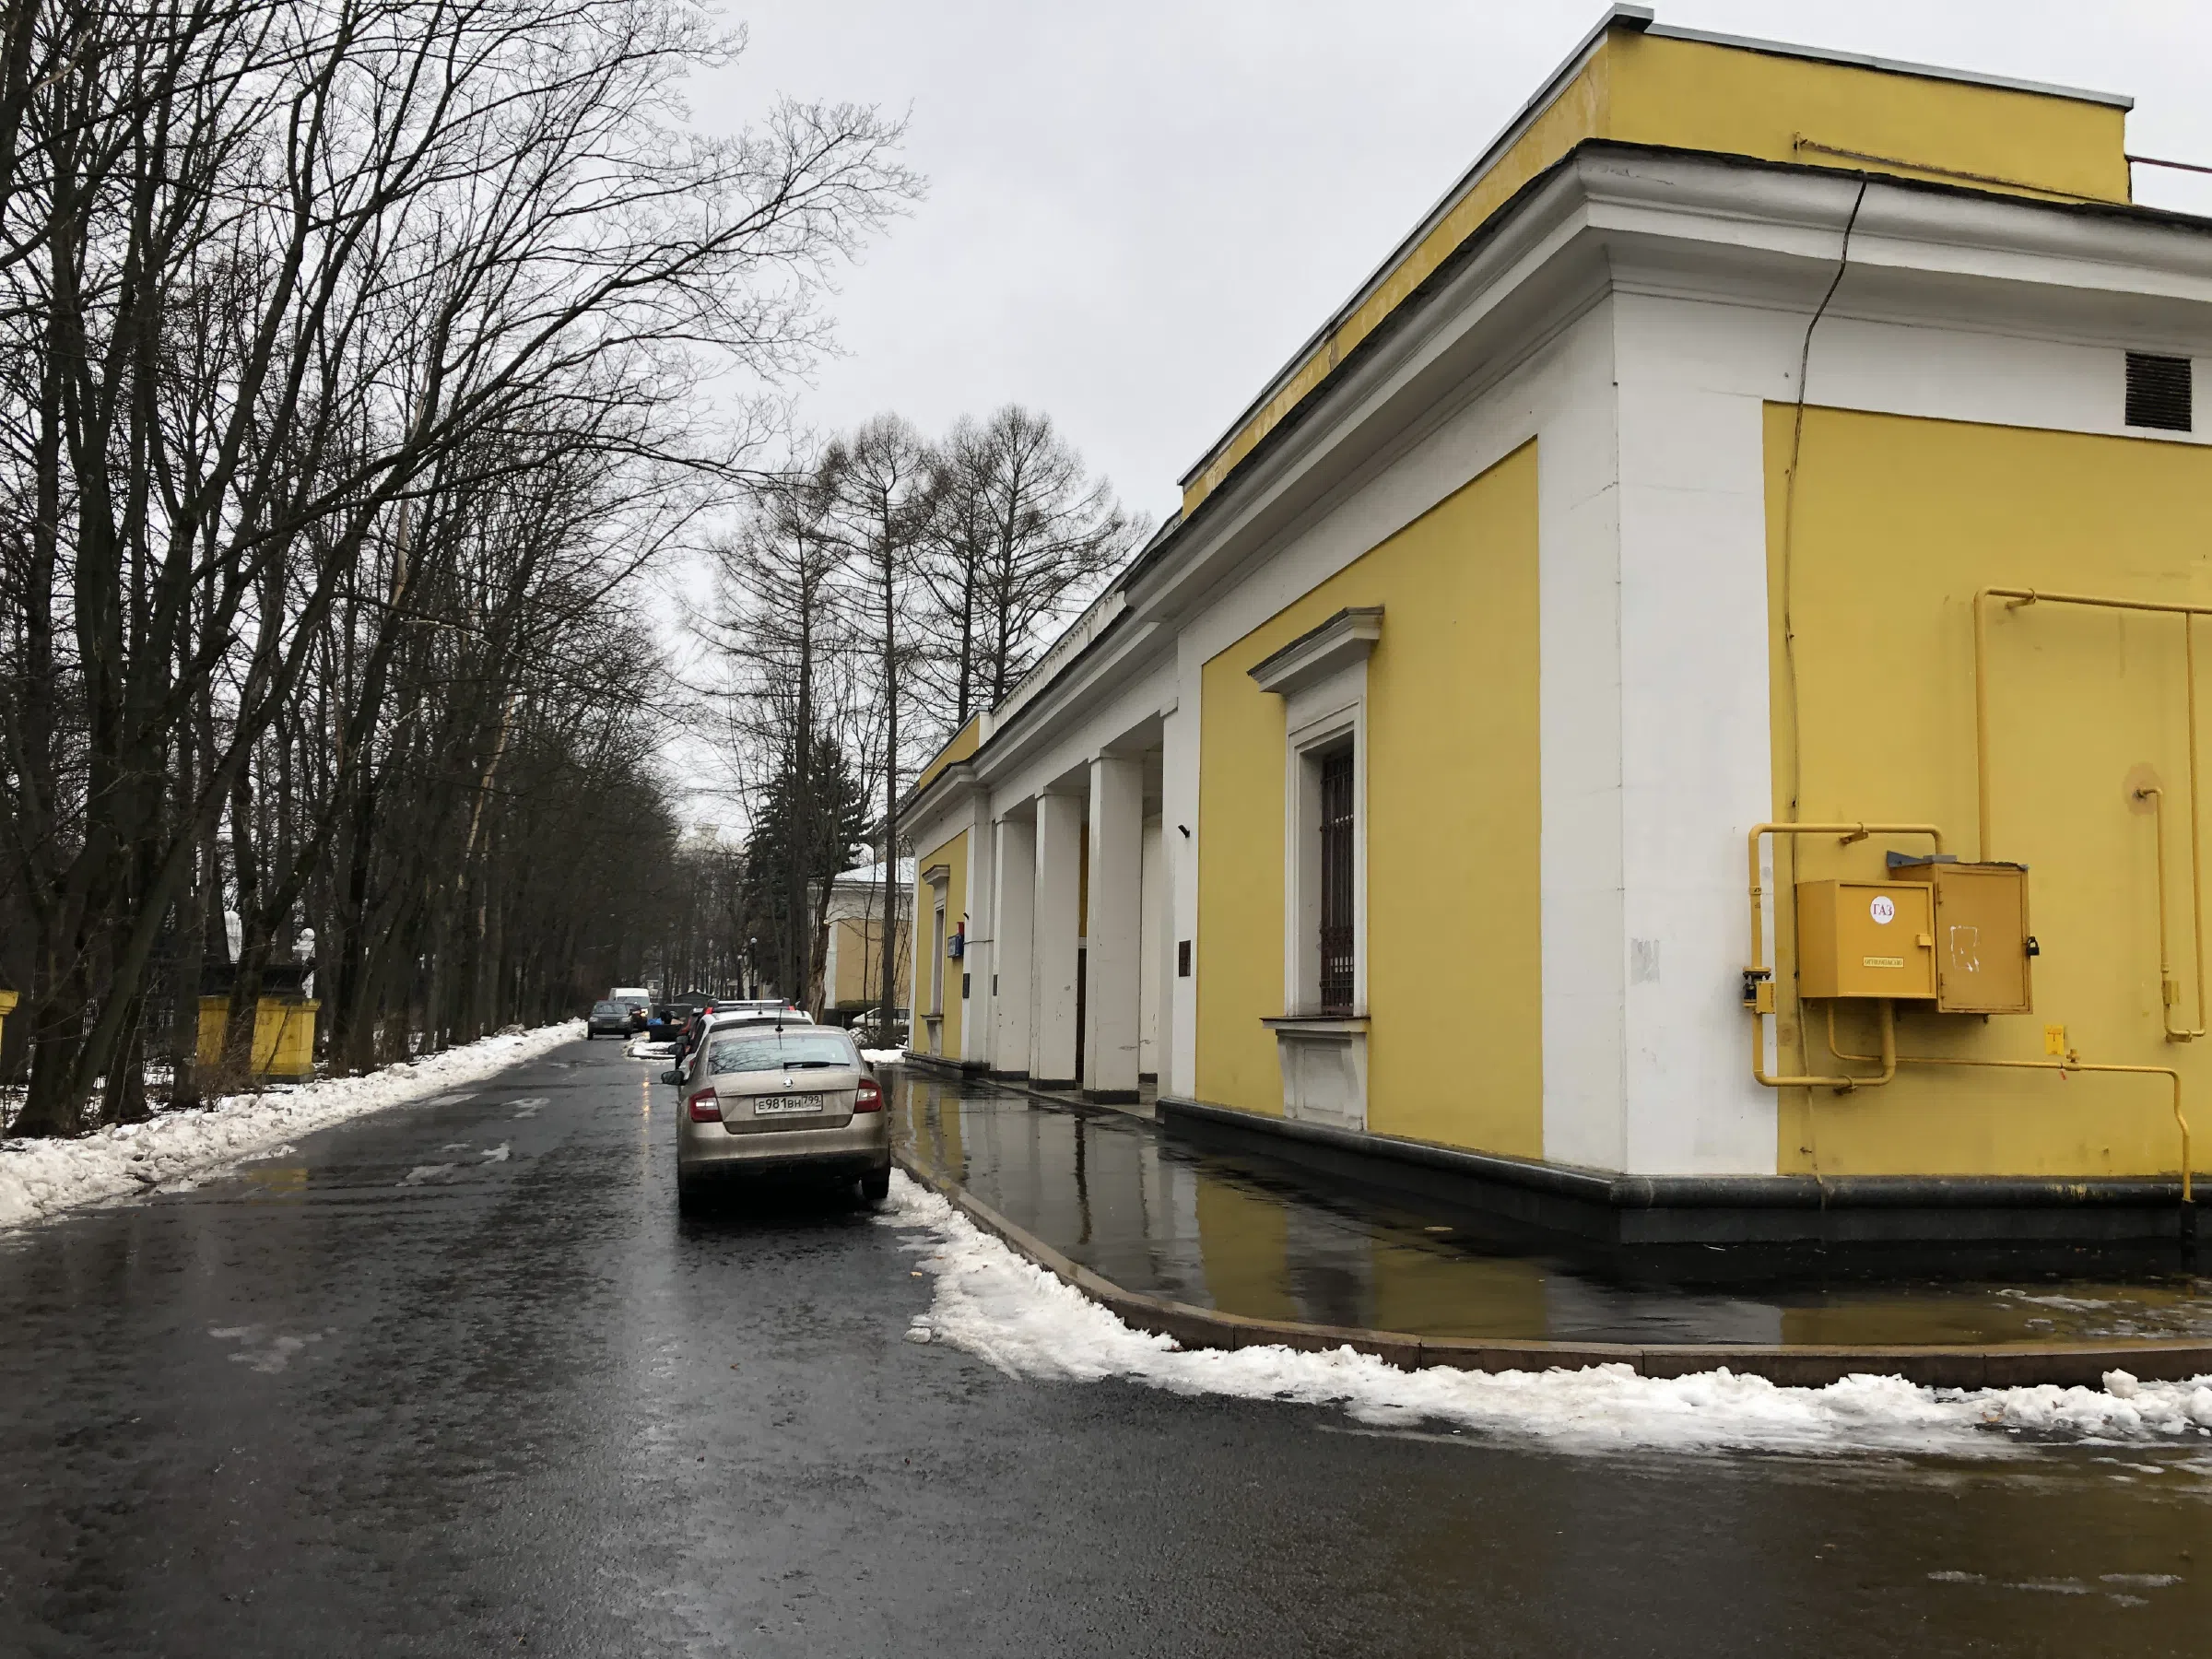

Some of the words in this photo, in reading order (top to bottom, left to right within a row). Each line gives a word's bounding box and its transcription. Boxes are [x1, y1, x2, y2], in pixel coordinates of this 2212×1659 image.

[1874, 904, 1892, 915] ГАЗ
[759, 1098, 801, 1110] Е981ВН
[803, 1095, 819, 1104] 799
